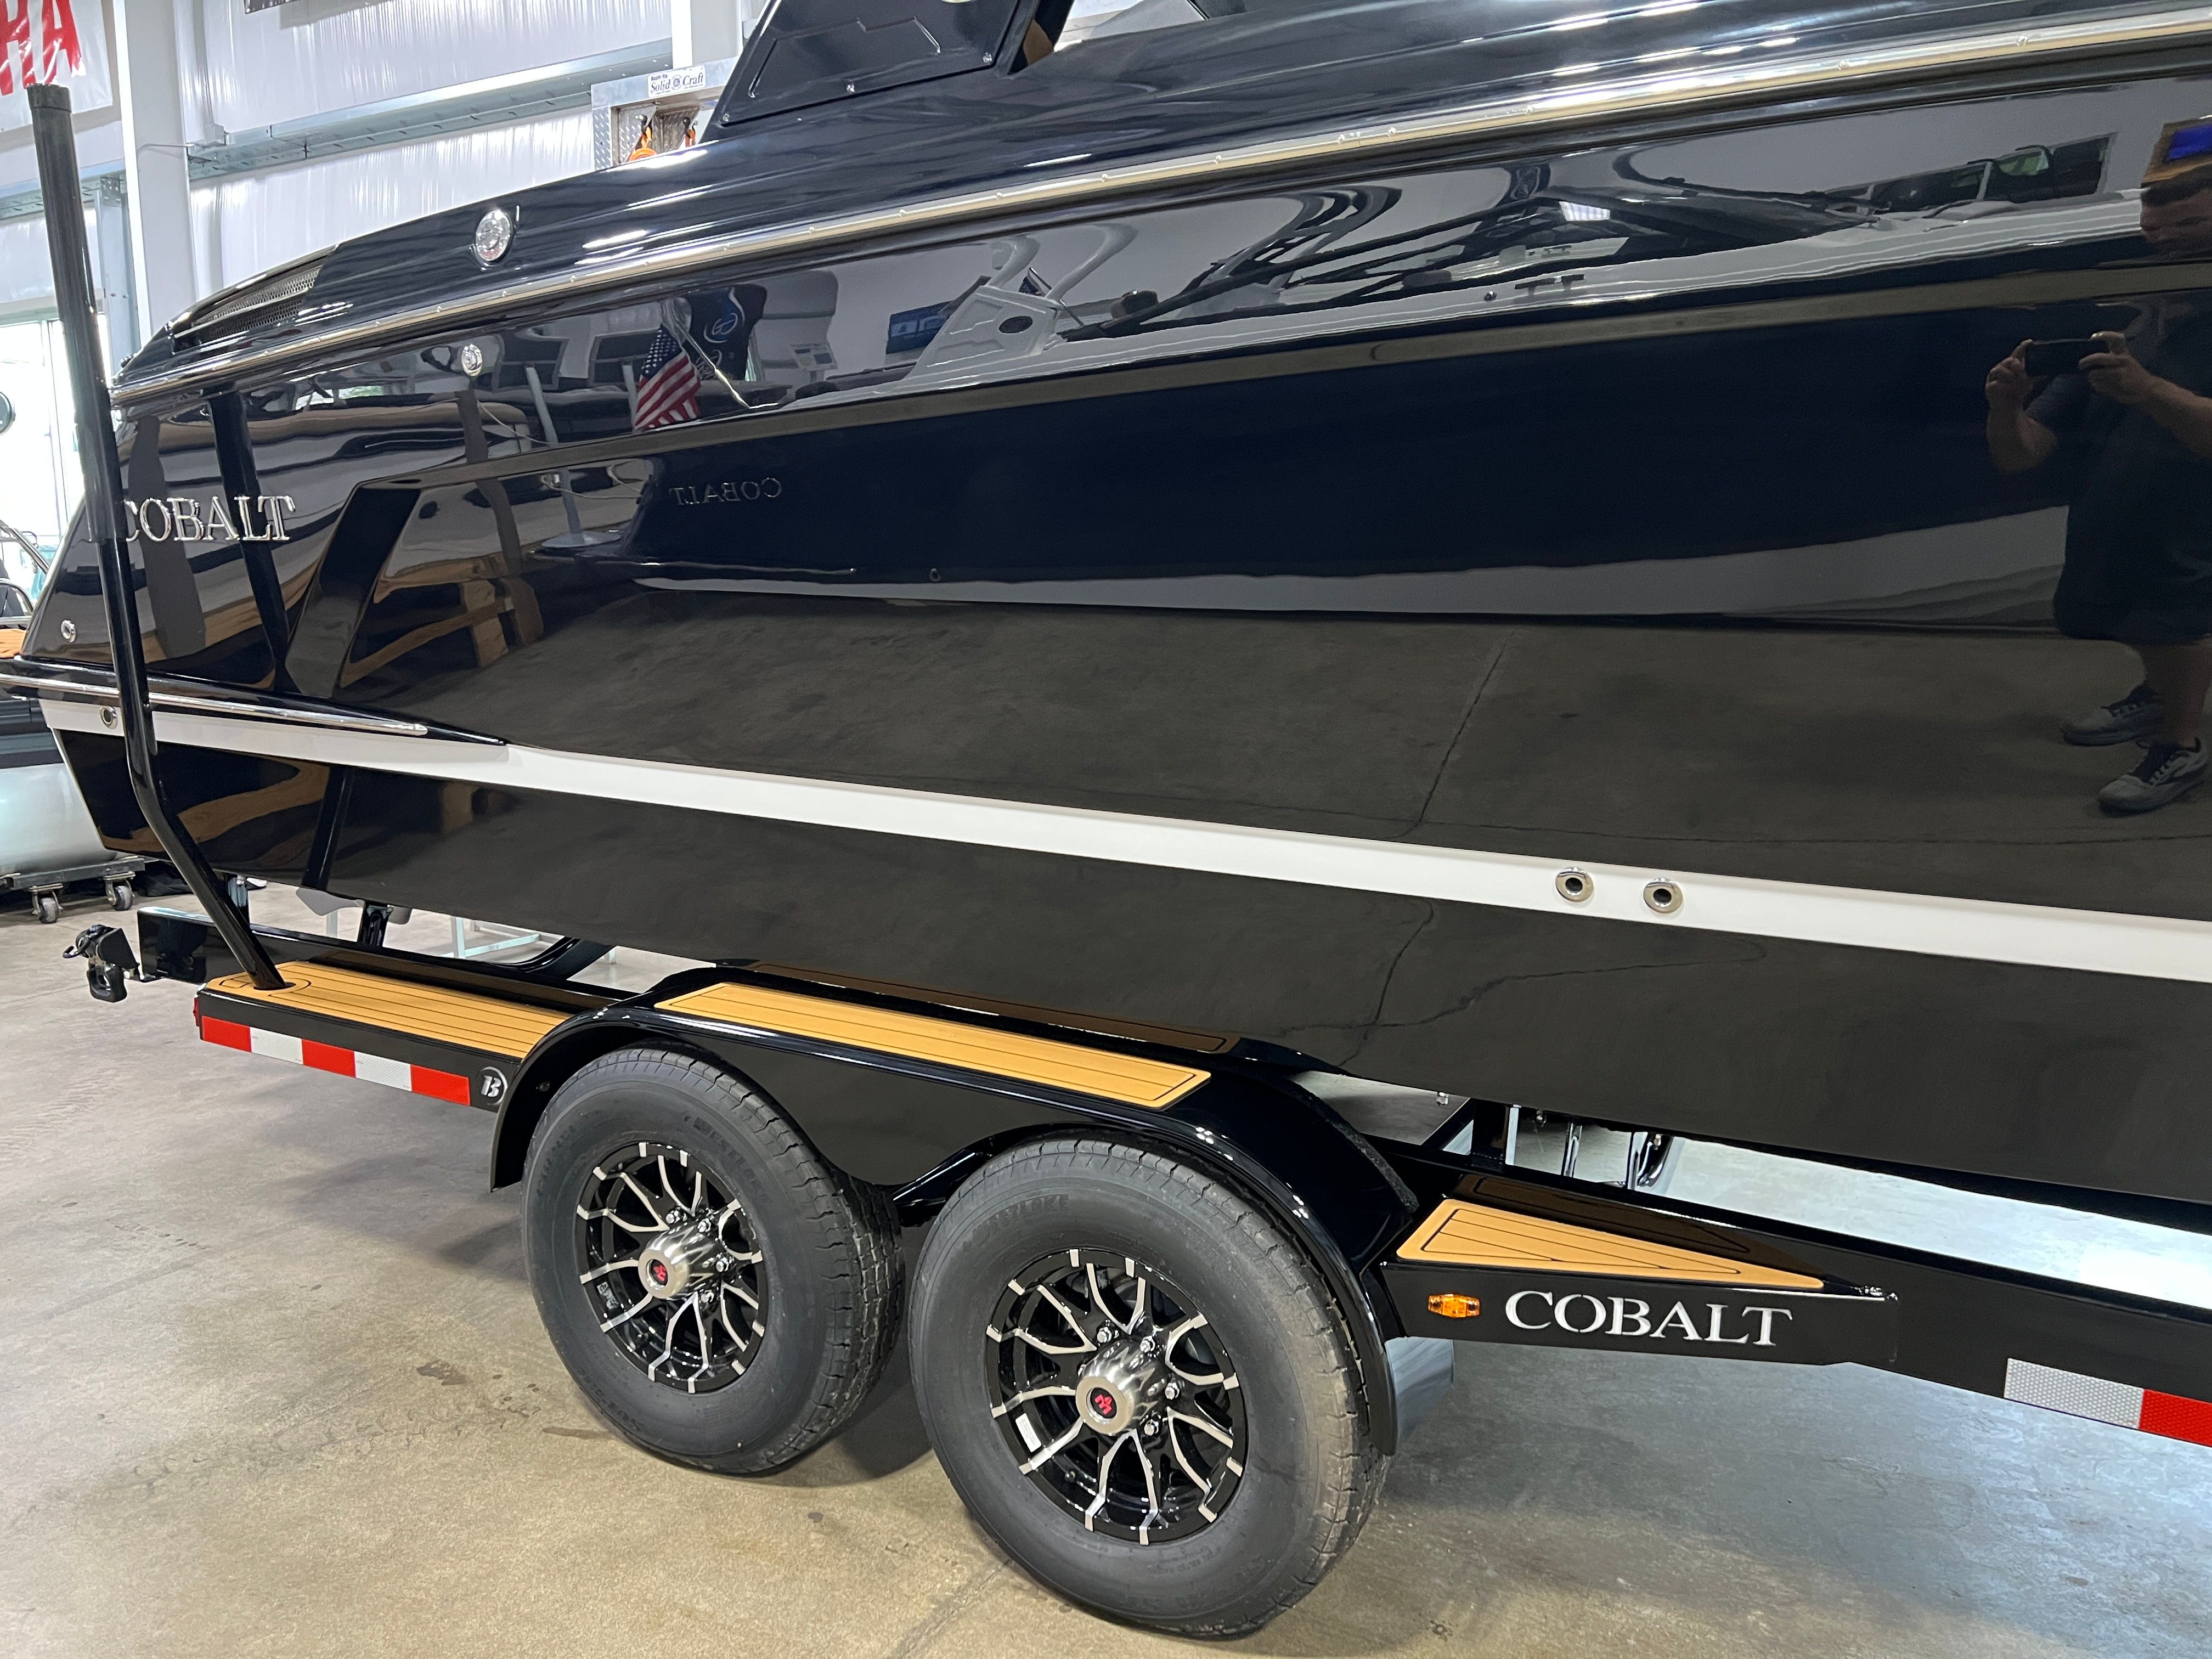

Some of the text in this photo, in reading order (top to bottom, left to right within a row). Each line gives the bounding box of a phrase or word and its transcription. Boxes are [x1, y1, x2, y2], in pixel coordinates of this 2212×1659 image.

[650, 78, 671, 94] Solid
[682, 72, 704, 86] Craft
[971, 1193, 1070, 1246] WESTLAKE
[1504, 1290, 1793, 1346] COBALT
